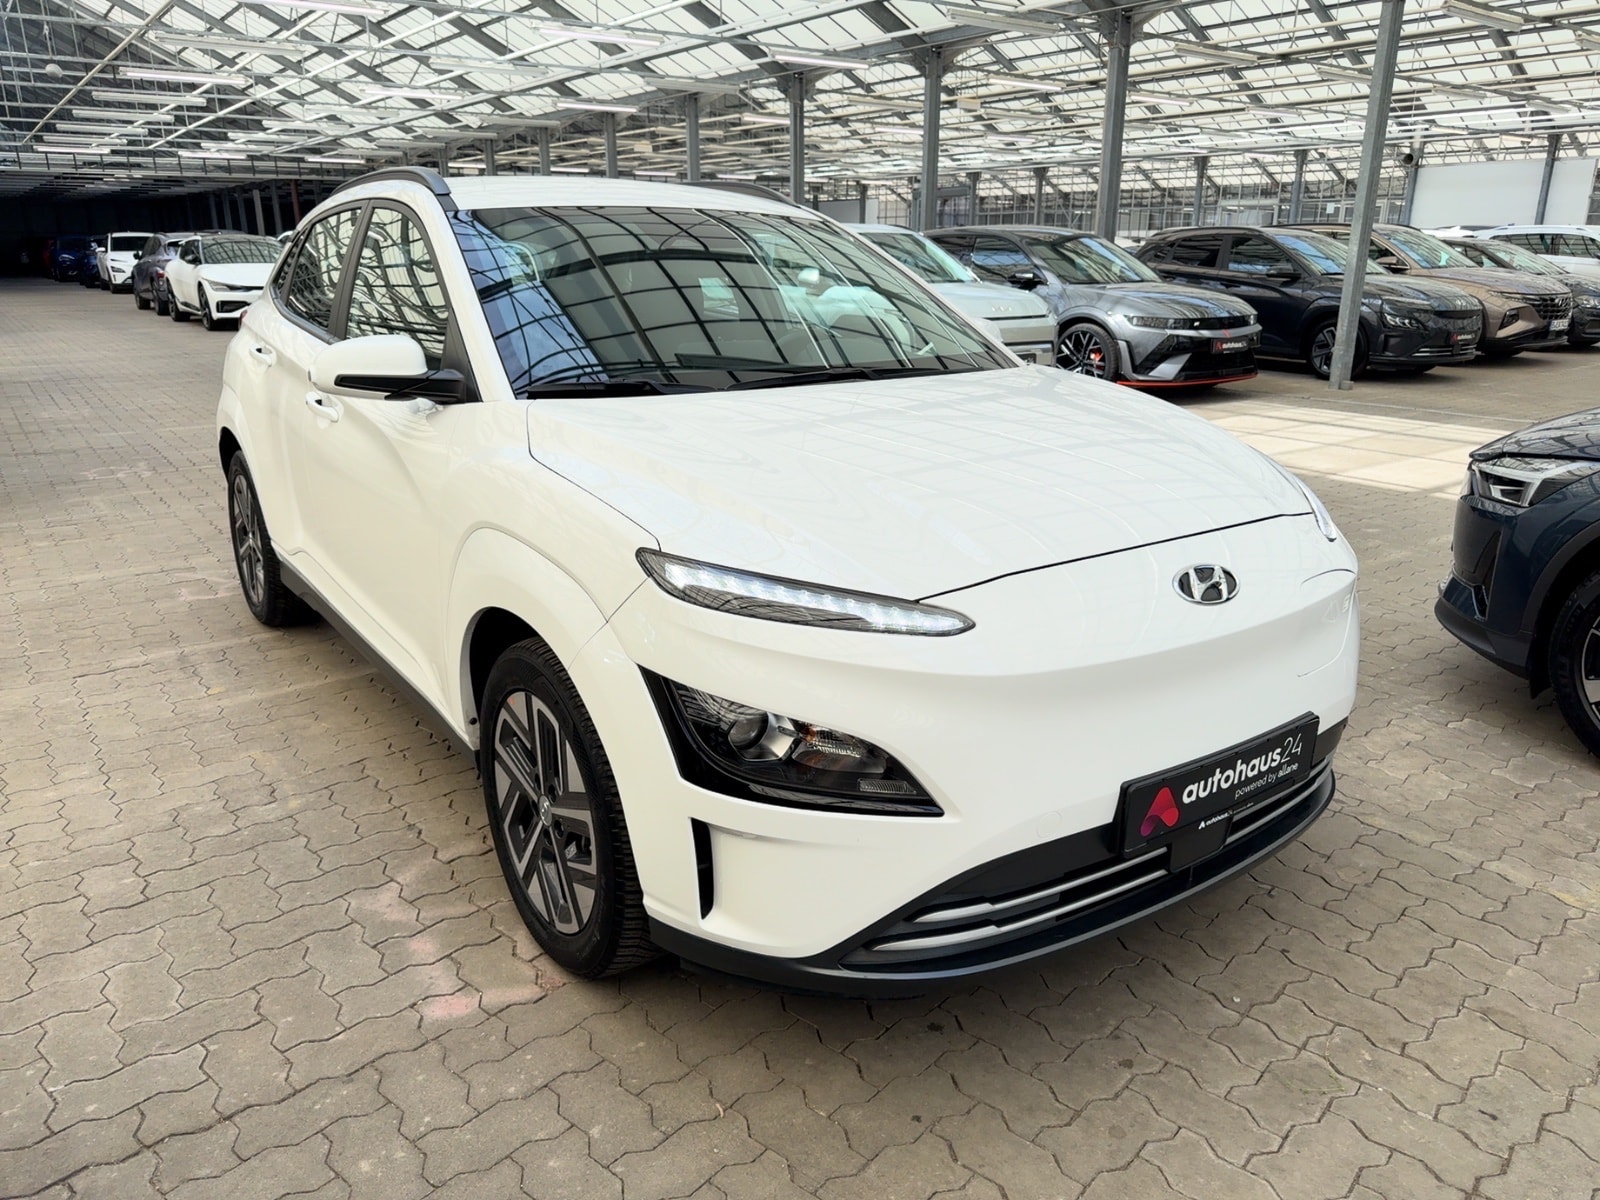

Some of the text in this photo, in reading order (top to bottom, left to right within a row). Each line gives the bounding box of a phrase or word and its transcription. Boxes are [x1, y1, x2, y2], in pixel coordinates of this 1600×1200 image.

[1182, 733, 1303, 804] autohaus24
[1234, 762, 1299, 800] powered by allane
